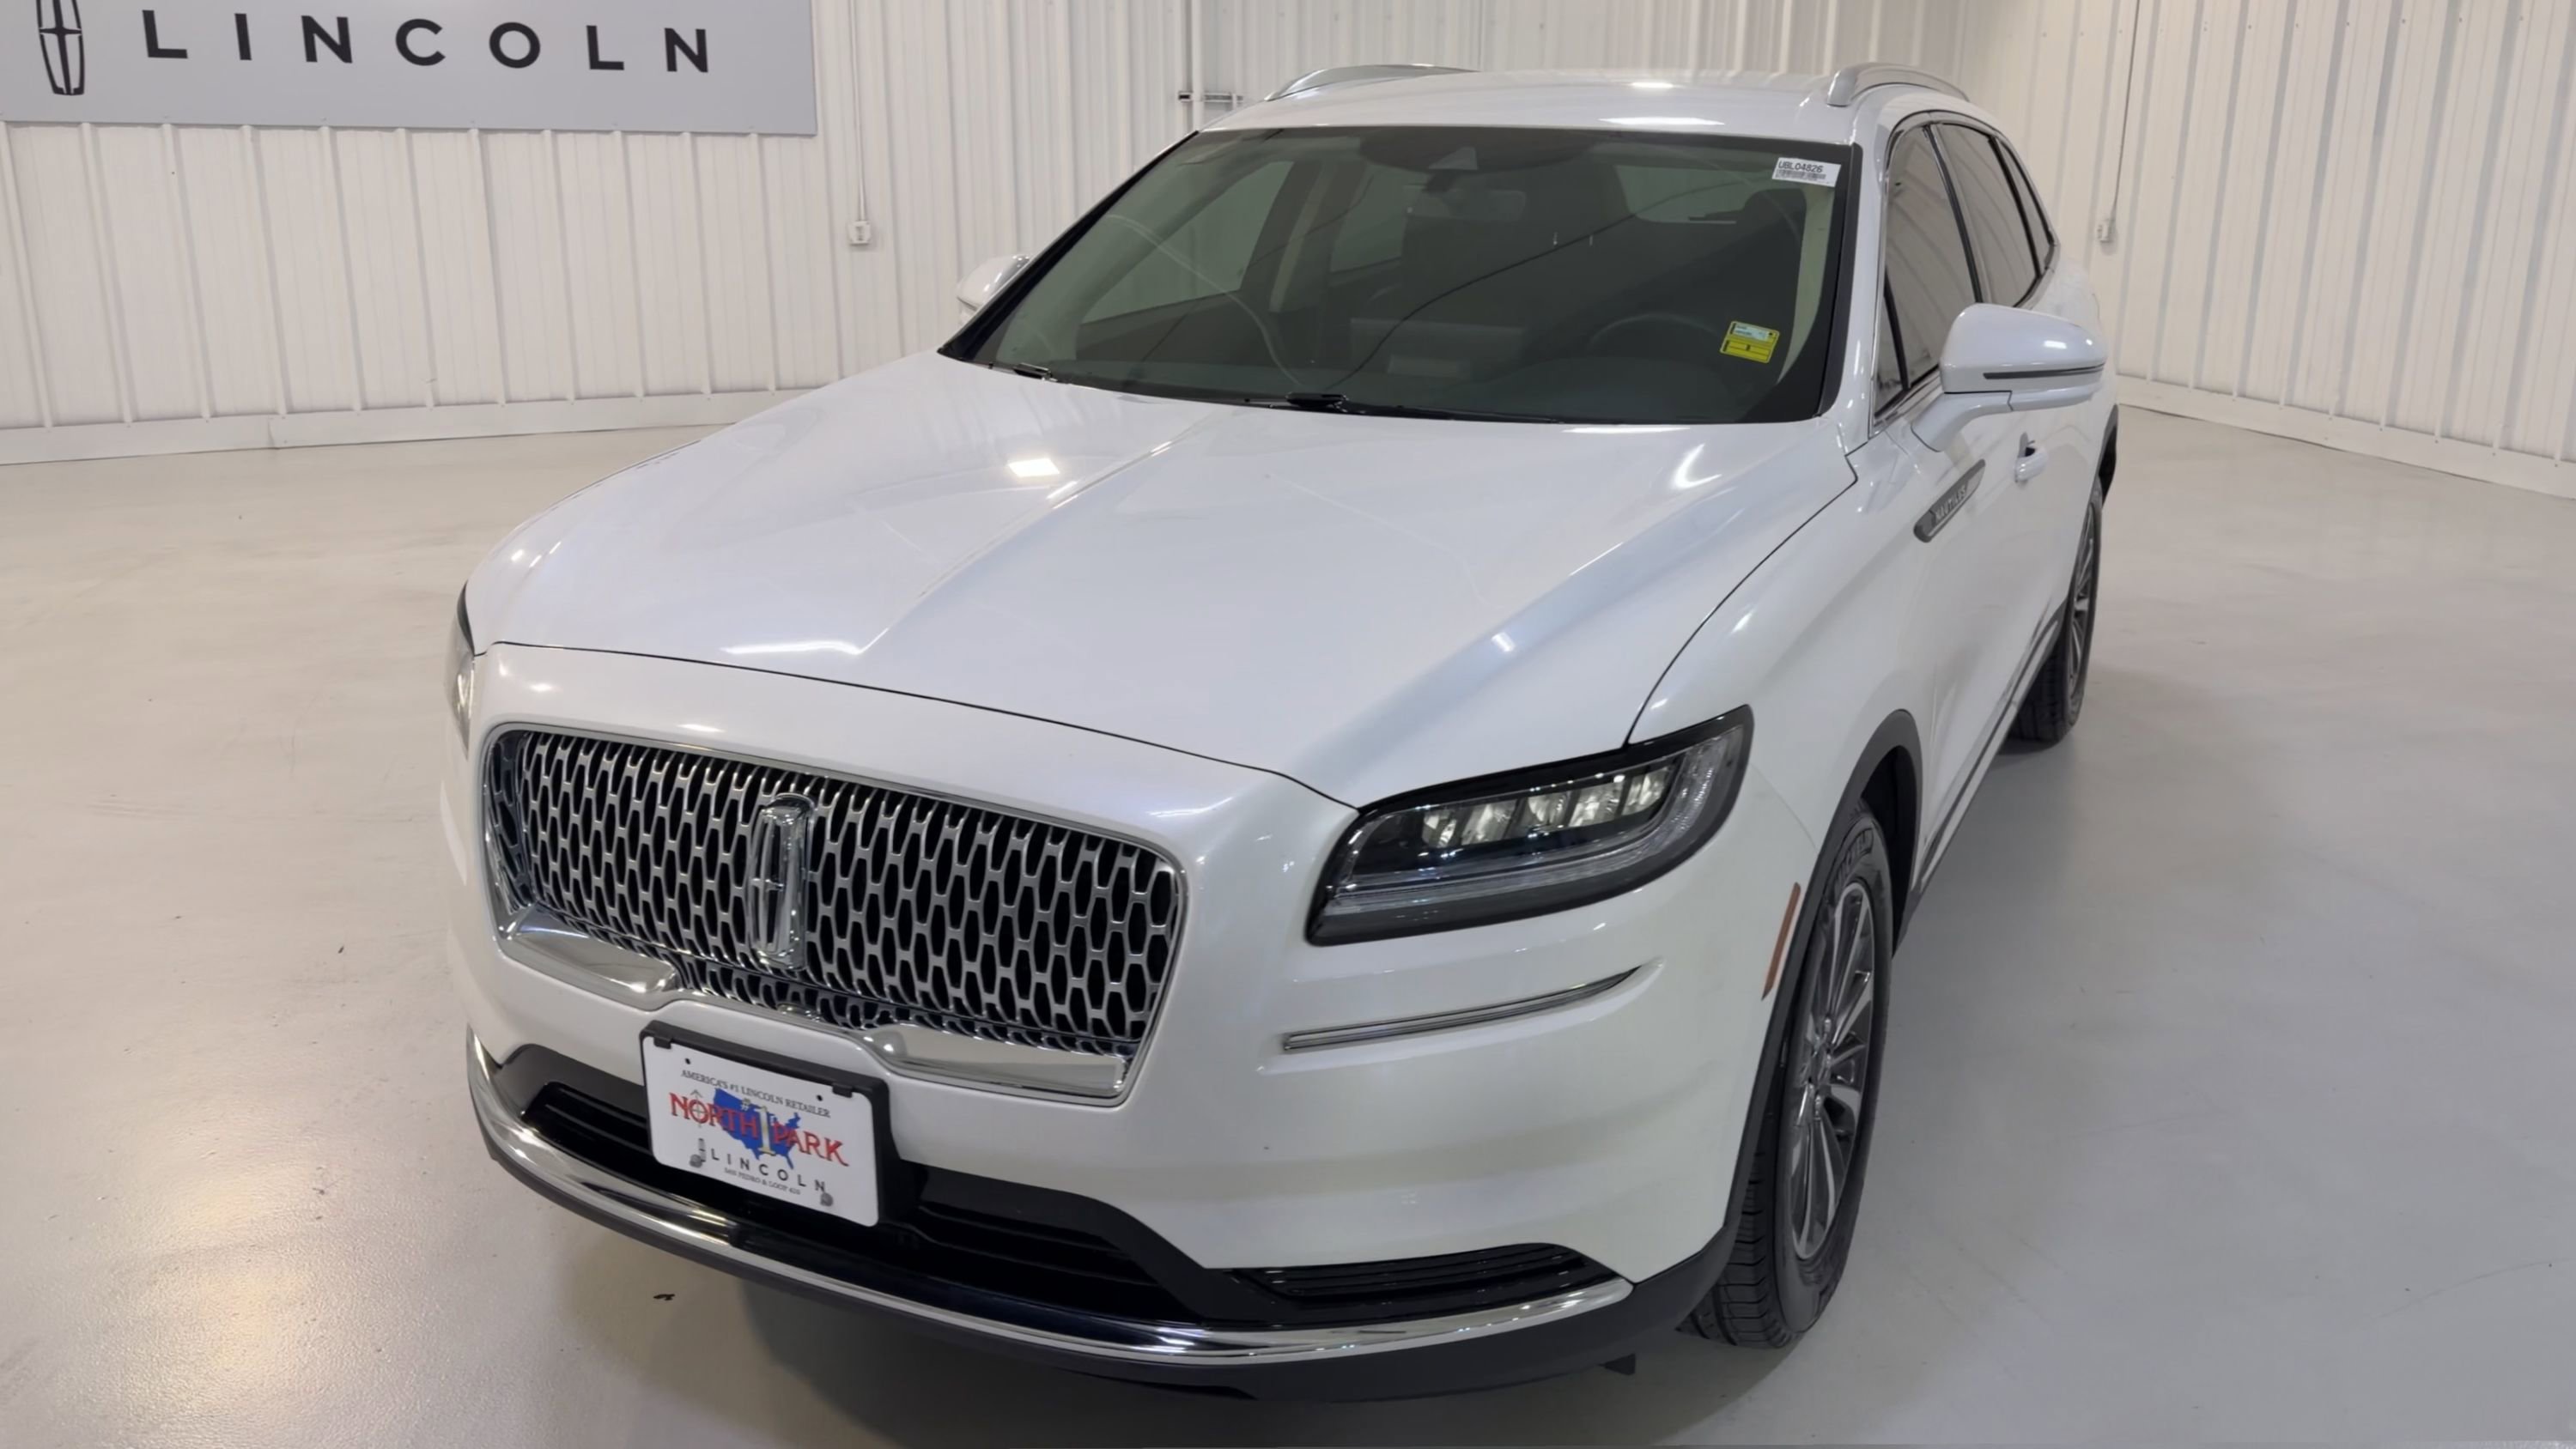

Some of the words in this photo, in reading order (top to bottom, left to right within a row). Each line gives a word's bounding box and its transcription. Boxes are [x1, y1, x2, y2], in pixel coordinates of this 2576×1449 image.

[142, 9, 709, 73] LINCOLN
[741, 1086, 783, 1105] LINCOLN
[785, 1099, 830, 1118] RETAILER
[669, 1093, 759, 1140] NORTH
[774, 1120, 849, 1167] PARK
[711, 1148, 825, 1192] LINCOLN
